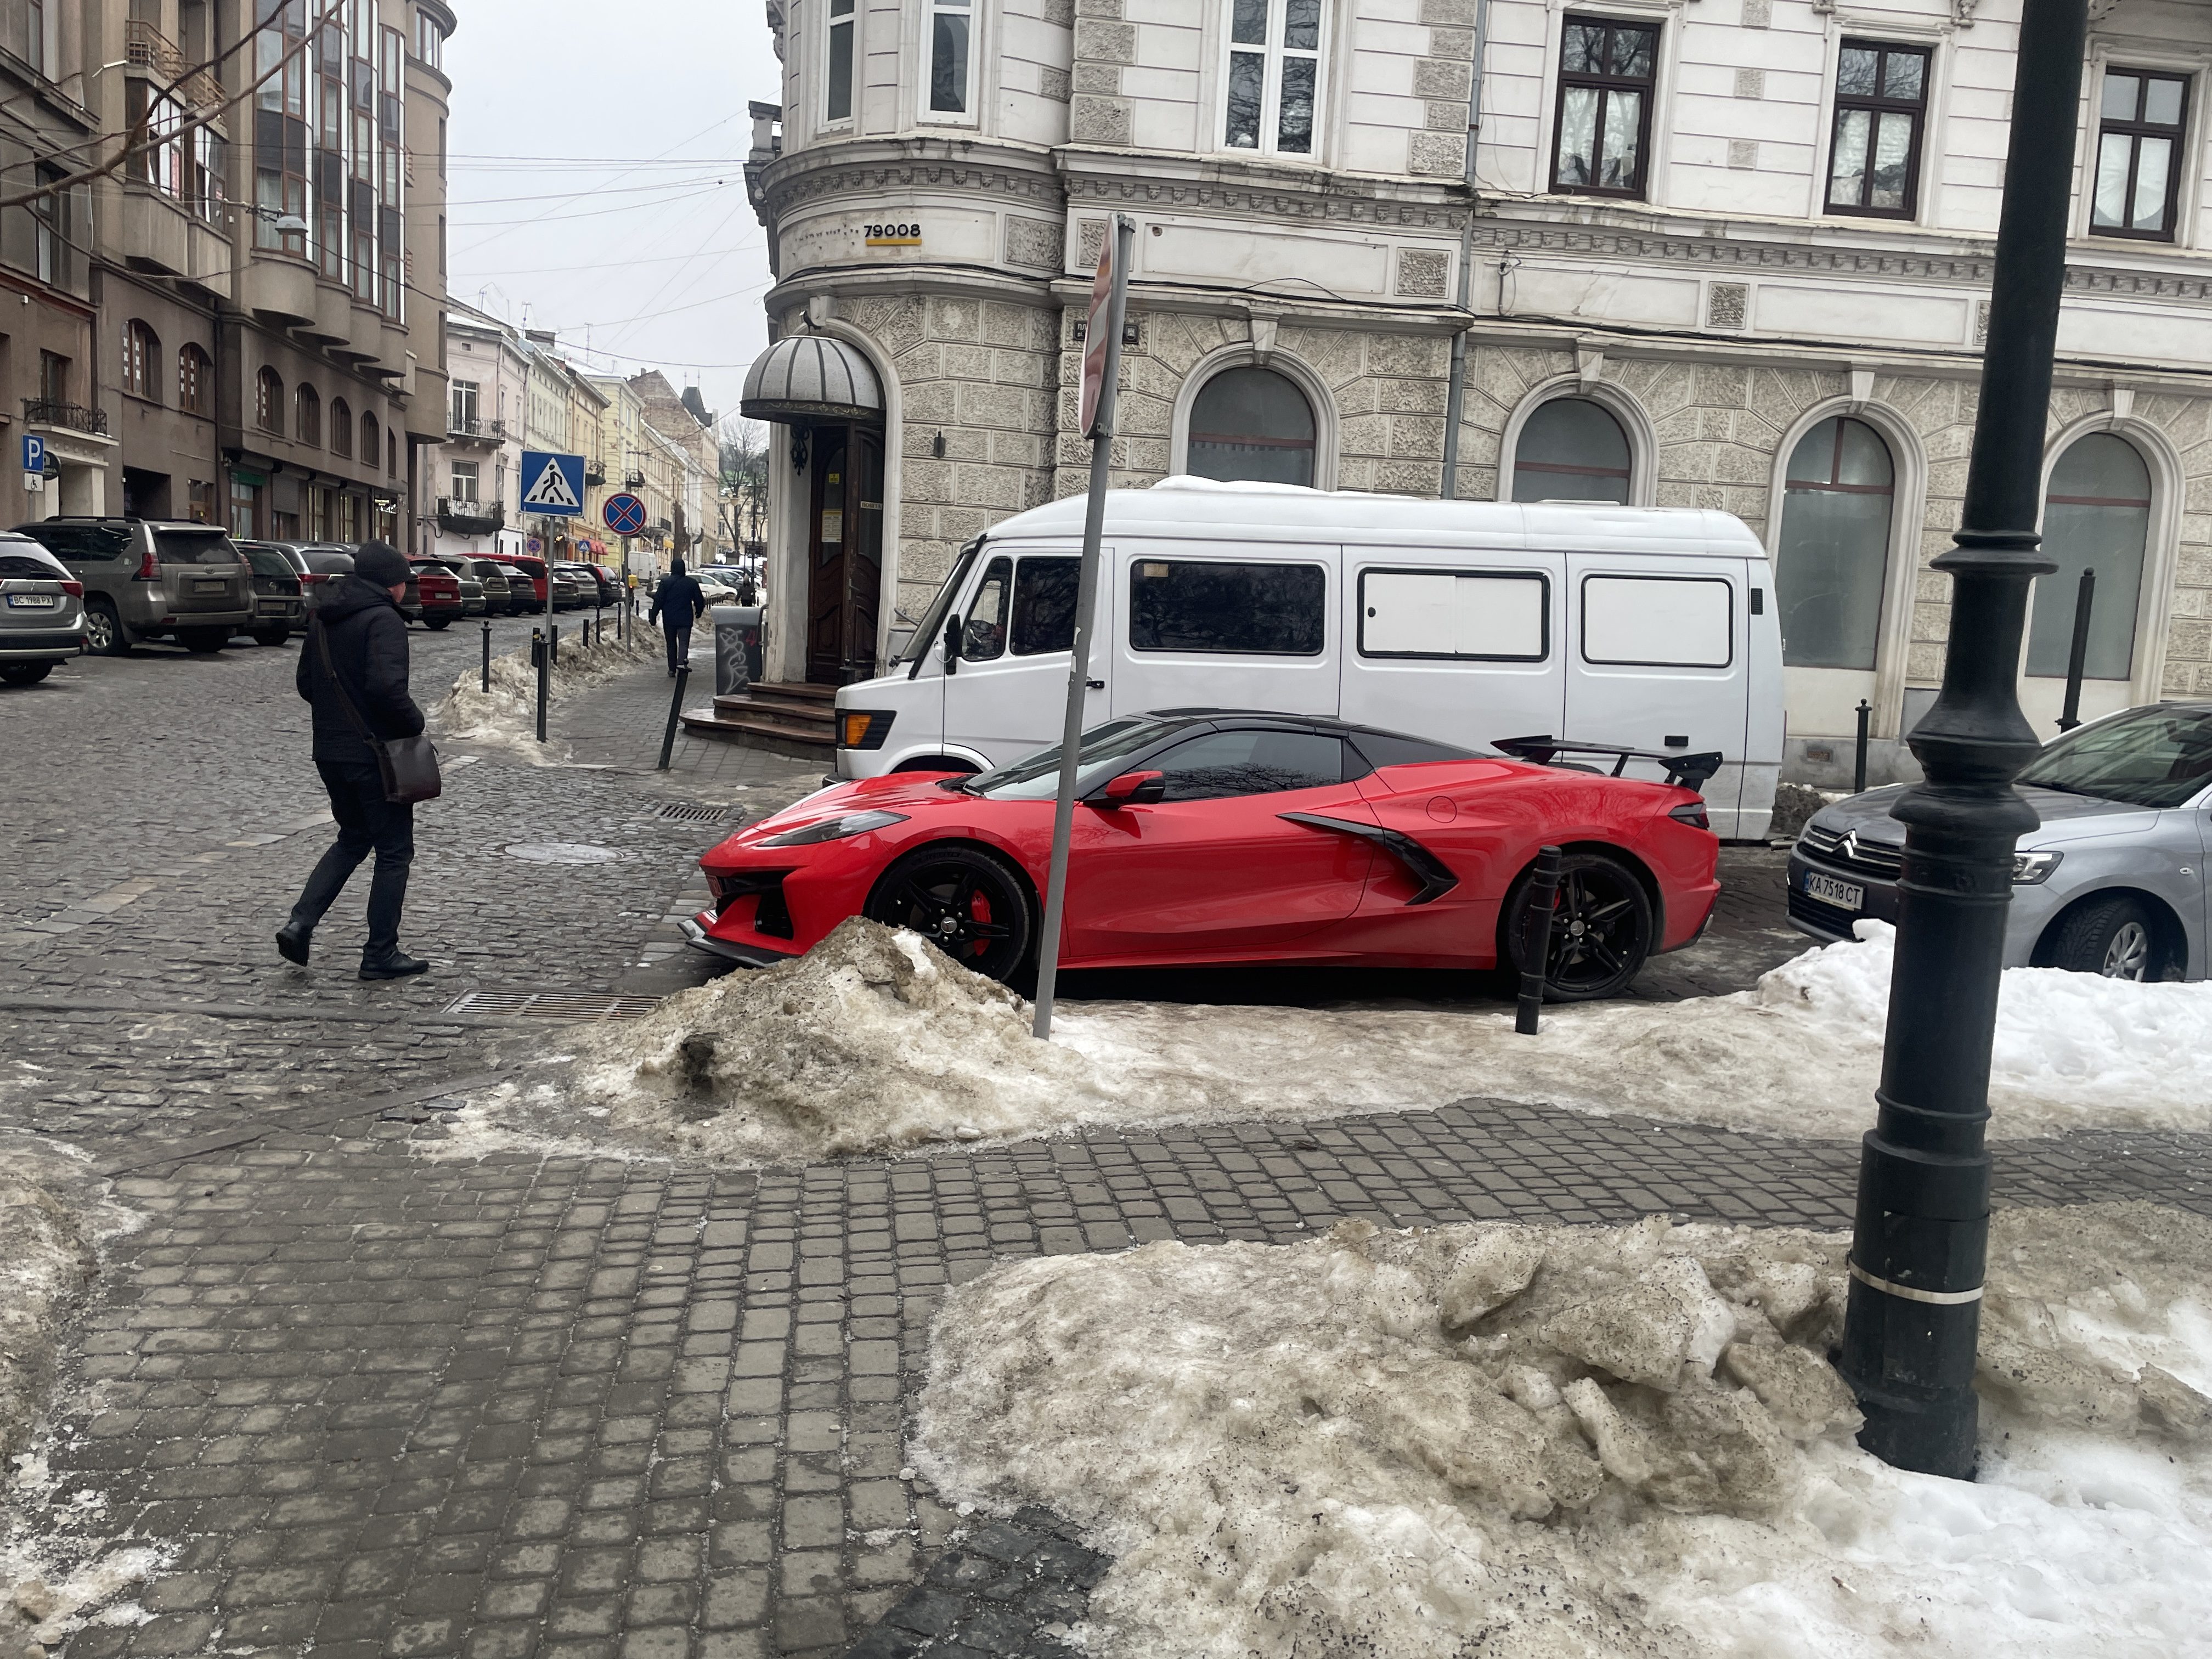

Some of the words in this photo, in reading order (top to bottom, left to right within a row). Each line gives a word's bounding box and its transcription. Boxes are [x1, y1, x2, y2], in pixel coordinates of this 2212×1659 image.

[864, 224, 921, 238] 79008
[29, 438, 41, 467] P
[1810, 875, 1821, 893] KA
[1823, 879, 1844, 899] 7518
[1846, 887, 1861, 904] CT
